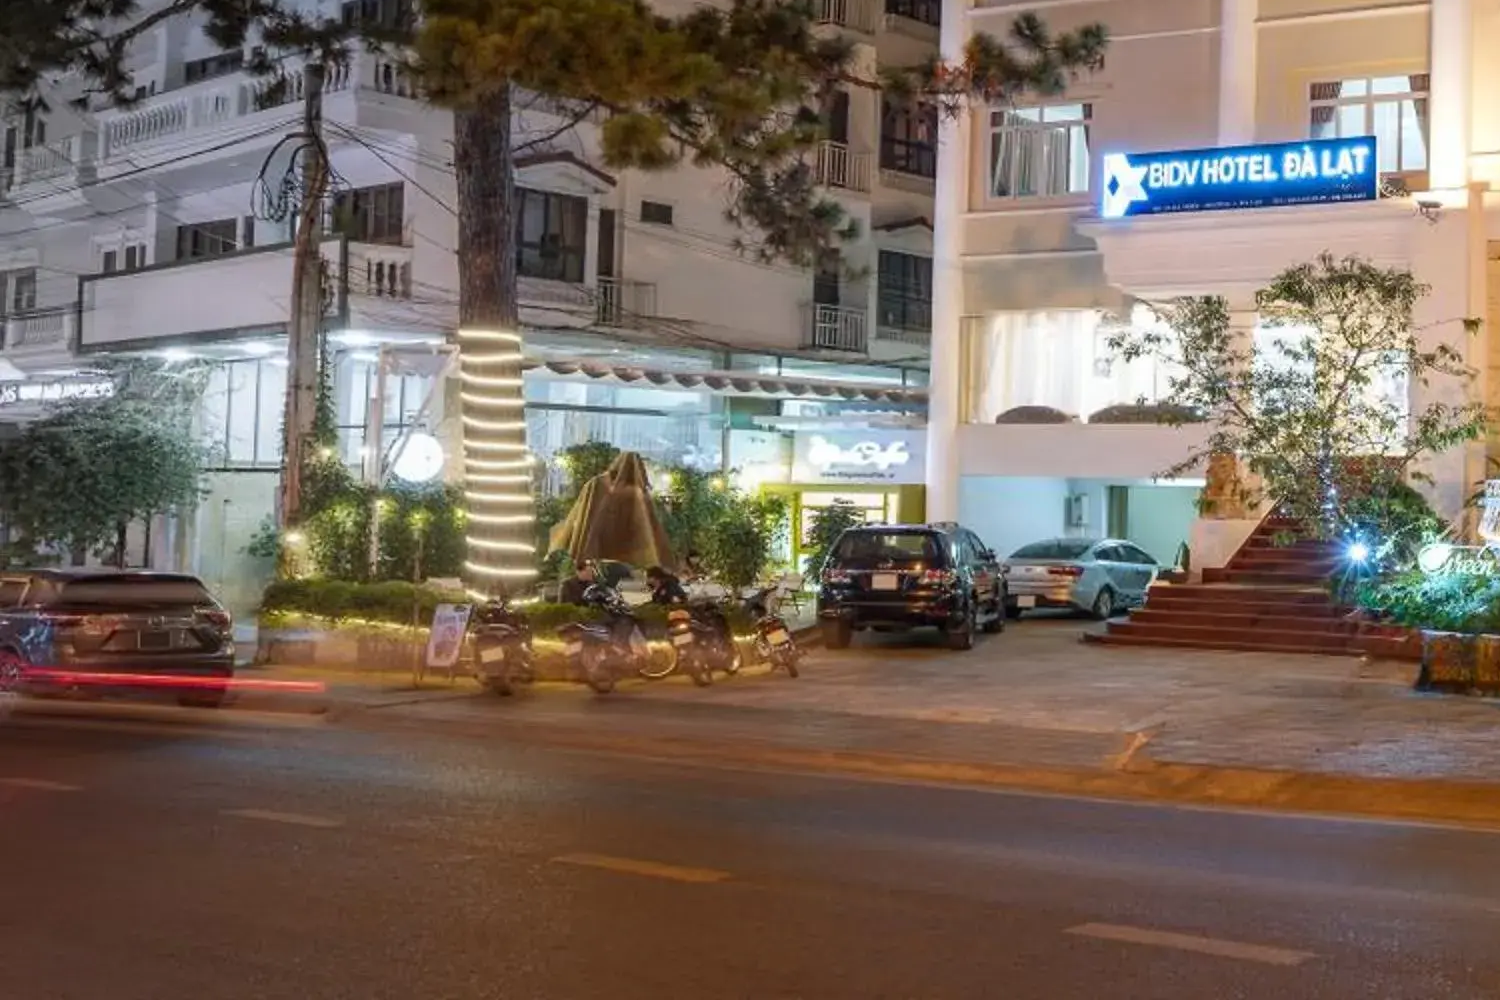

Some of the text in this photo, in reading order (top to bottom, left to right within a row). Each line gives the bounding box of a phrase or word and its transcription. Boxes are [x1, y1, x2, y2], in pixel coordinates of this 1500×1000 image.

[1149, 144, 1370, 188] BIDV HOTEL ĐÀ LẠT
